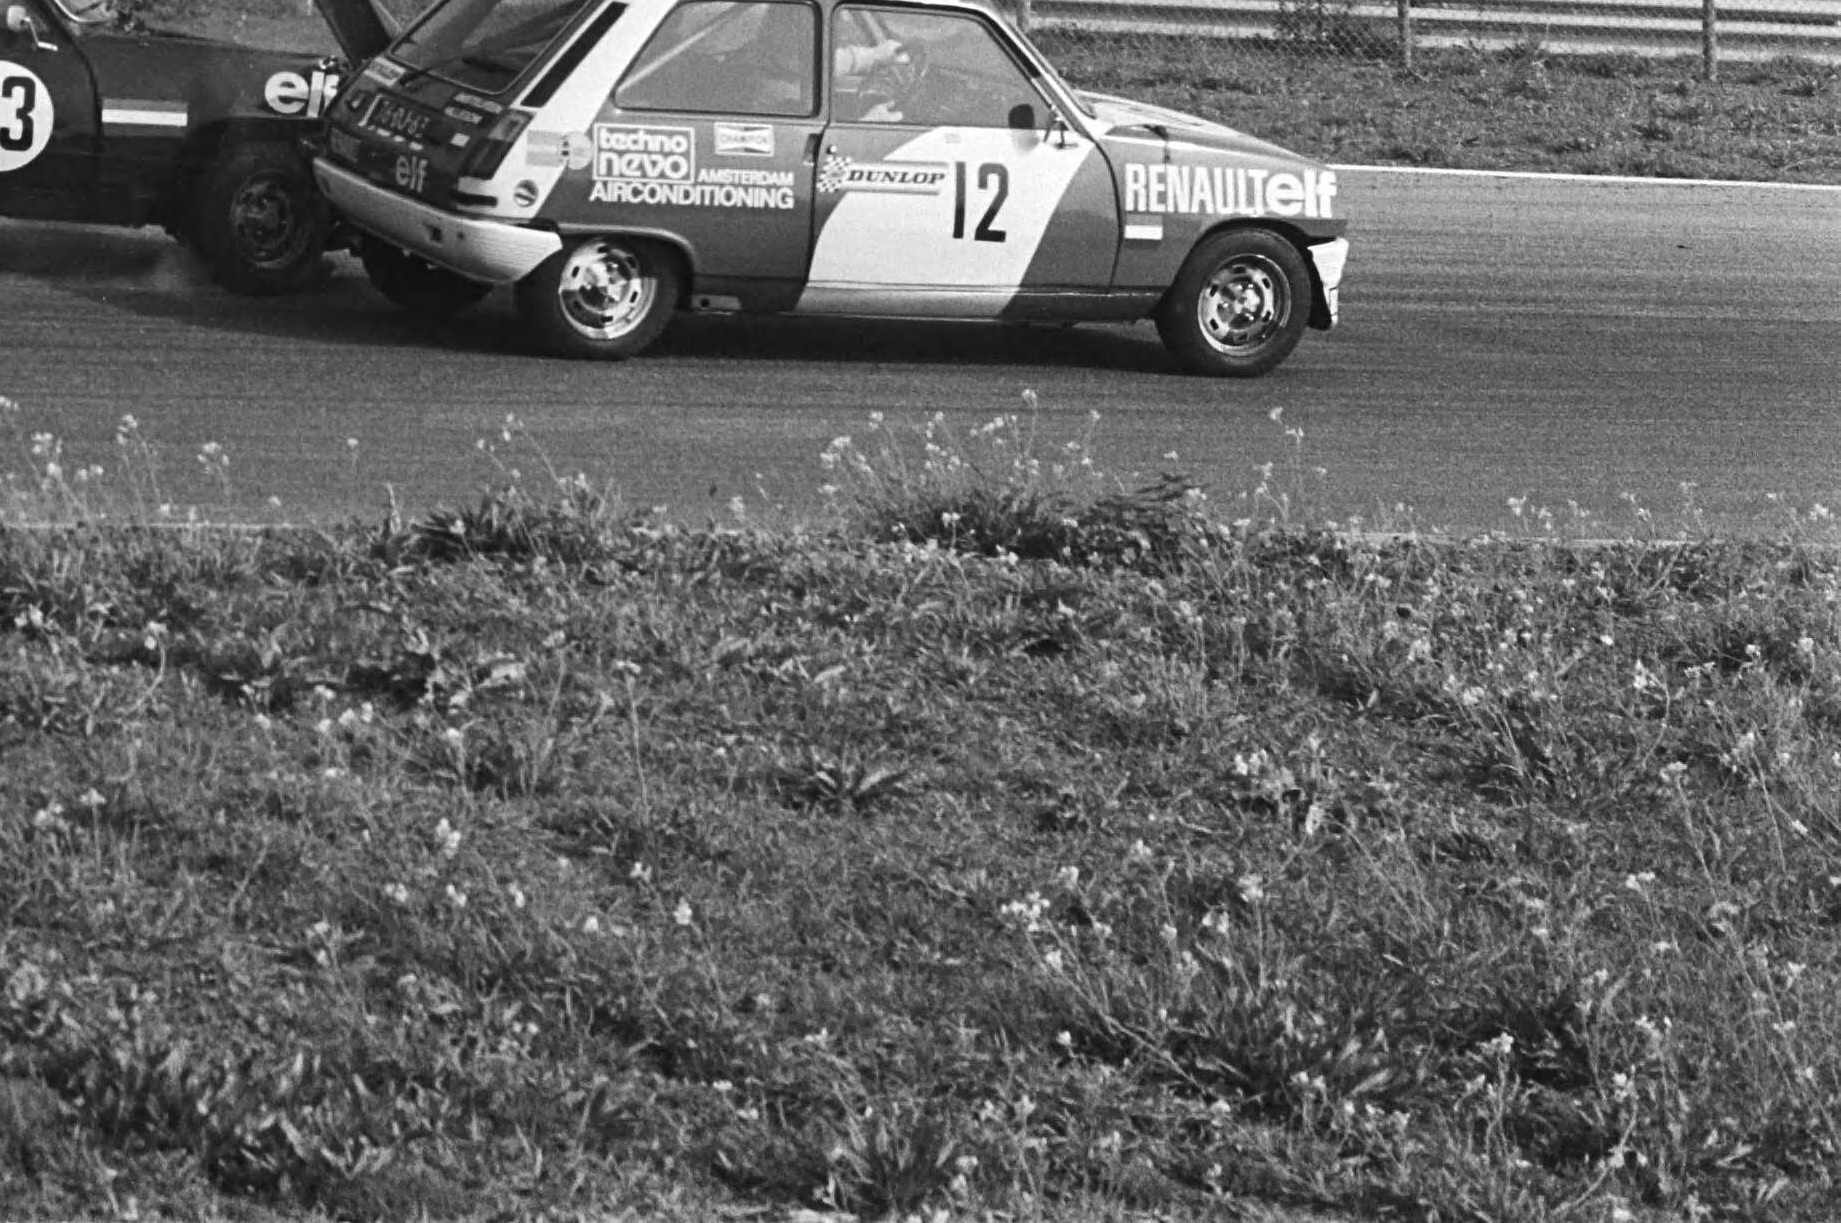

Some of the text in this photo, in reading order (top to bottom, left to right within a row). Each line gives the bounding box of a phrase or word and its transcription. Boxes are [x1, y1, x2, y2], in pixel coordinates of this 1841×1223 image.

[599, 128, 689, 154] techno
[395, 155, 429, 194] elf
[598, 151, 689, 179] nevo
[698, 168, 795, 187] AMSTERDAM
[847, 170, 946, 185] DUNLOP
[589, 182, 795, 209] AIRCONDITIONING
[952, 161, 1009, 243] 12
